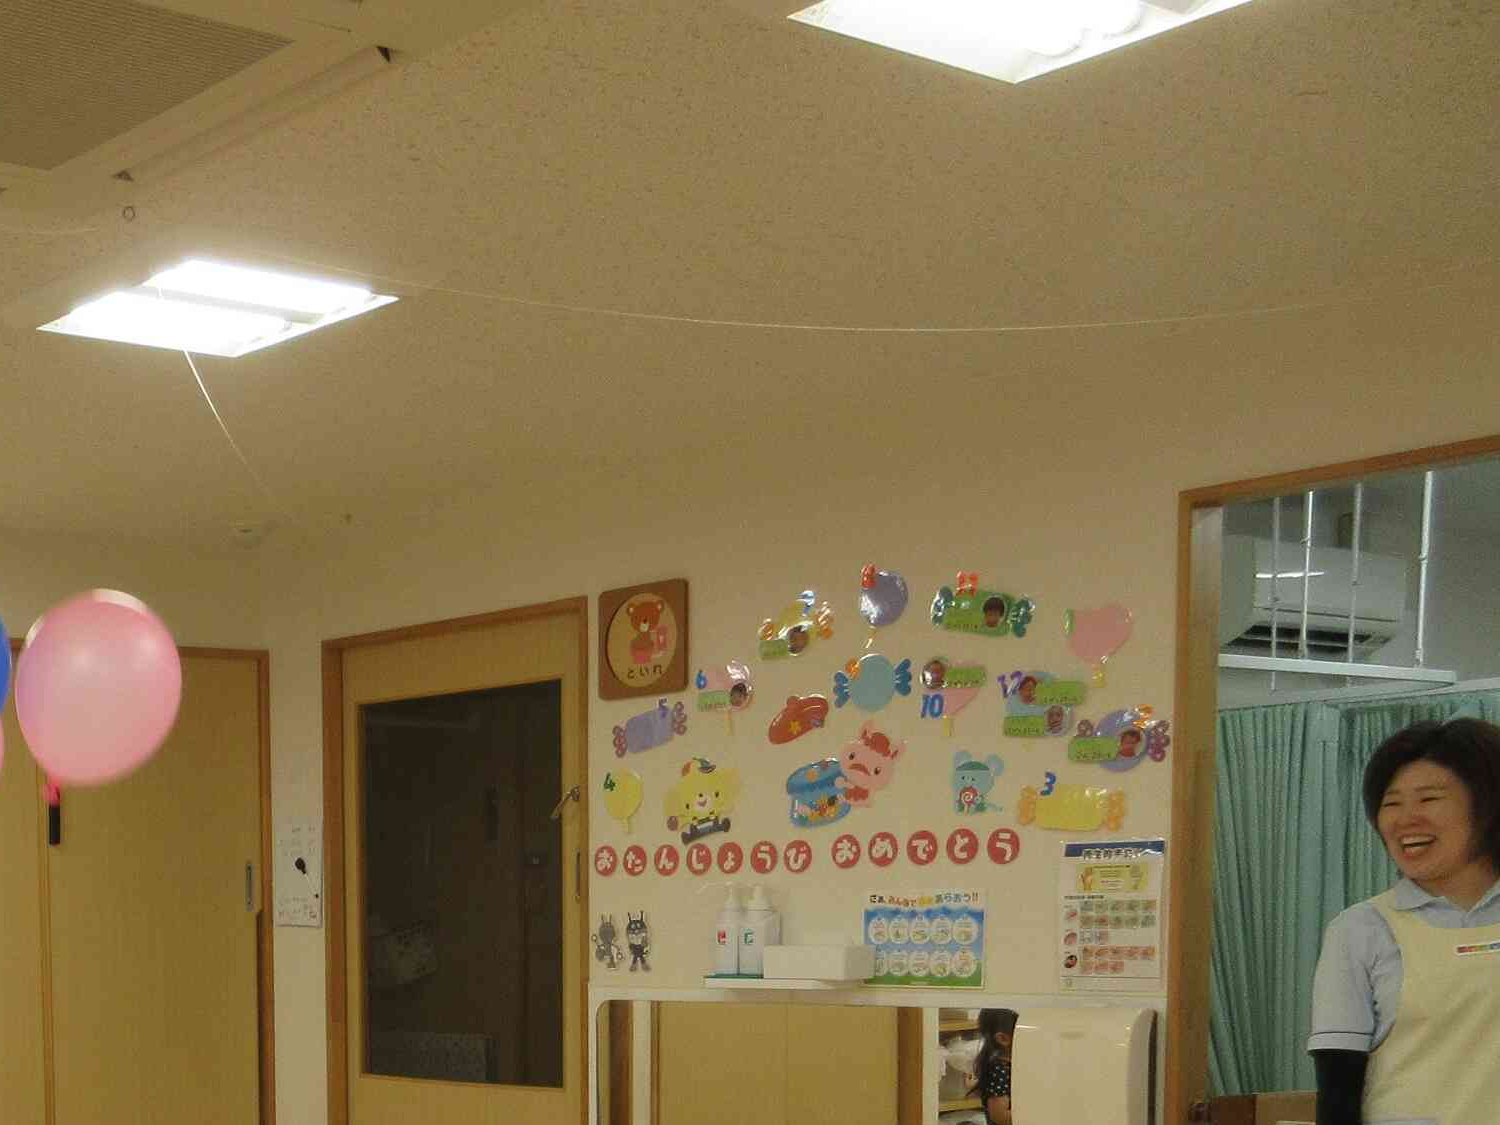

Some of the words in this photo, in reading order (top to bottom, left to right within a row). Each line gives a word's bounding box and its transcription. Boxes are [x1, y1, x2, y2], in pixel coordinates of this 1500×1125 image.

[695, 669, 708, 690] 6
[921, 693, 944, 718] 10
[603, 772, 616, 791] 4
[1040, 771, 1056, 796] 3
[596, 843, 809, 873] おたんじょうび
[834, 831, 1012, 864] おめでとう
